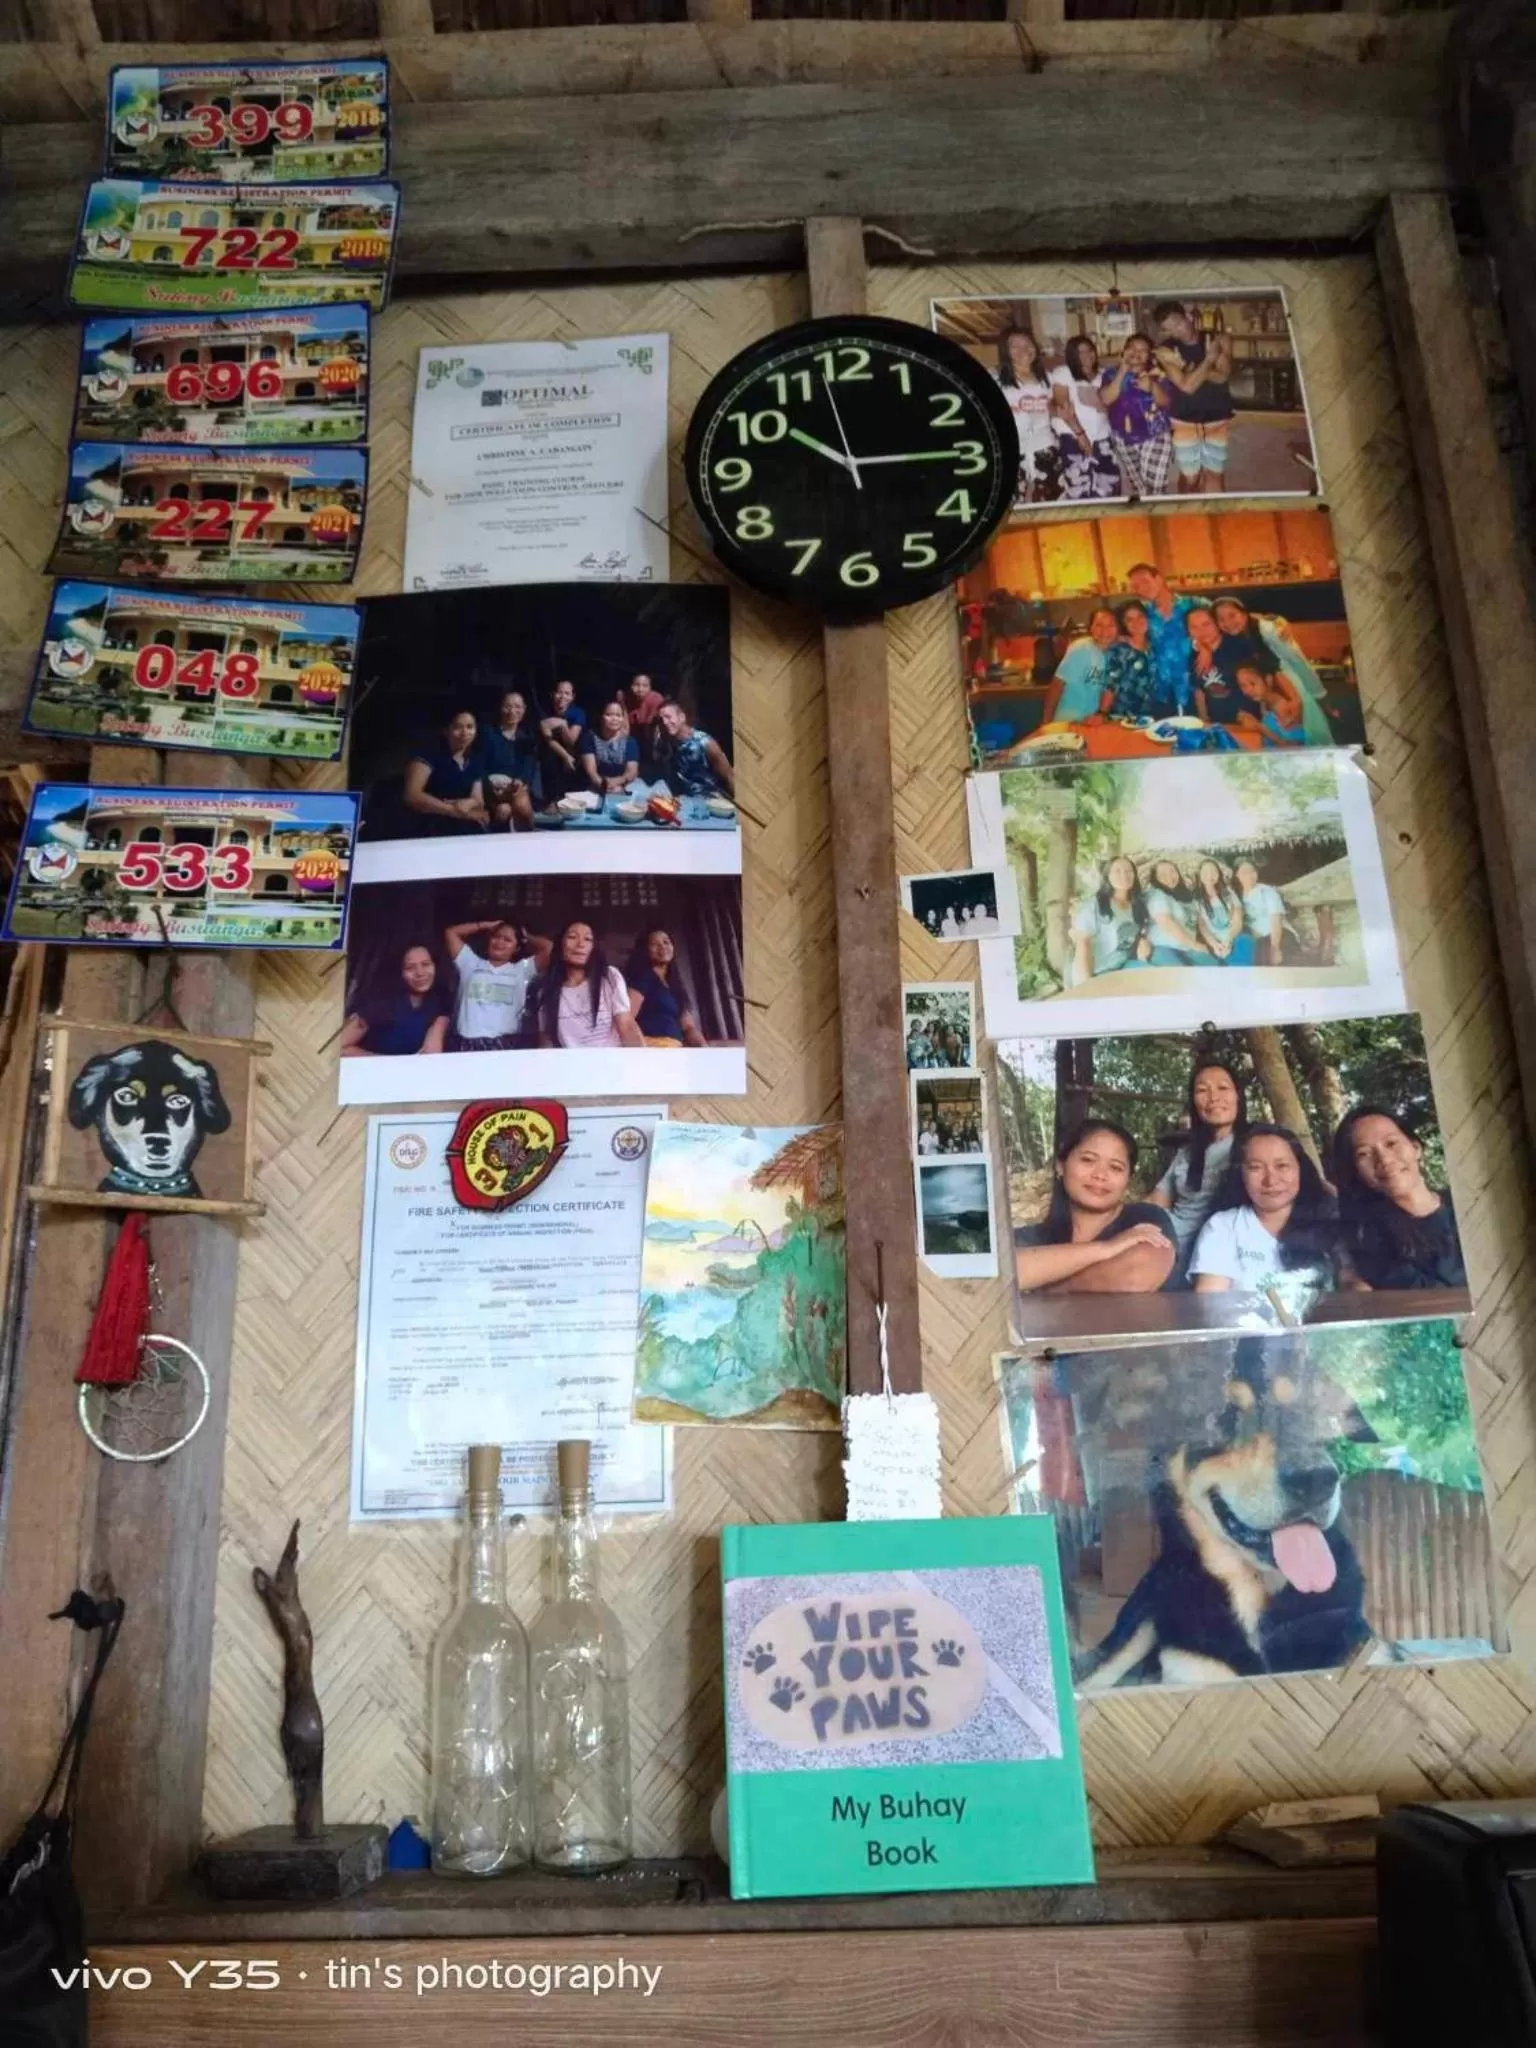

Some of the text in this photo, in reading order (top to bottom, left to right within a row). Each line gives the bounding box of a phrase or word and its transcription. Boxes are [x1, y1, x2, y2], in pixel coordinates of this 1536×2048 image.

[186, 103, 313, 148] 399
[311, 188, 352, 197] PERMIT
[179, 227, 301, 271] 722
[341, 239, 386, 258] 2019
[165, 360, 283, 406] 696
[319, 365, 361, 384] 2020
[813, 347, 874, 384] 12
[889, 362, 912, 395] 1
[502, 384, 589, 401] OPTIMAL
[766, 370, 813, 406] 11
[928, 392, 966, 427] 2
[727, 409, 789, 447] 10
[714, 457, 753, 493] 9
[952, 440, 988, 476] 3
[150, 499, 277, 541] 227
[310, 515, 354, 533] 2021
[735, 505, 775, 541] 8
[935, 489, 977, 525] 4
[784, 538, 822, 576] 7
[901, 531, 938, 569] 5
[839, 551, 880, 588] 6
[133, 643, 260, 698] 048
[299, 672, 342, 694] 2022
[118, 841, 253, 890] 533
[294, 861, 341, 880] 2023
[467, 1112, 527, 1165] HOUSE OF PAIN
[408, 1206, 434, 1217] FIRE
[553, 1200, 626, 1213] CERTIFICATE
[802, 1601, 919, 1643] WIPE
[801, 1641, 931, 1689] YOUR
[809, 1685, 931, 1743] PAWS
[831, 1790, 968, 1829] My Buhay
[867, 1837, 939, 1867] Book
